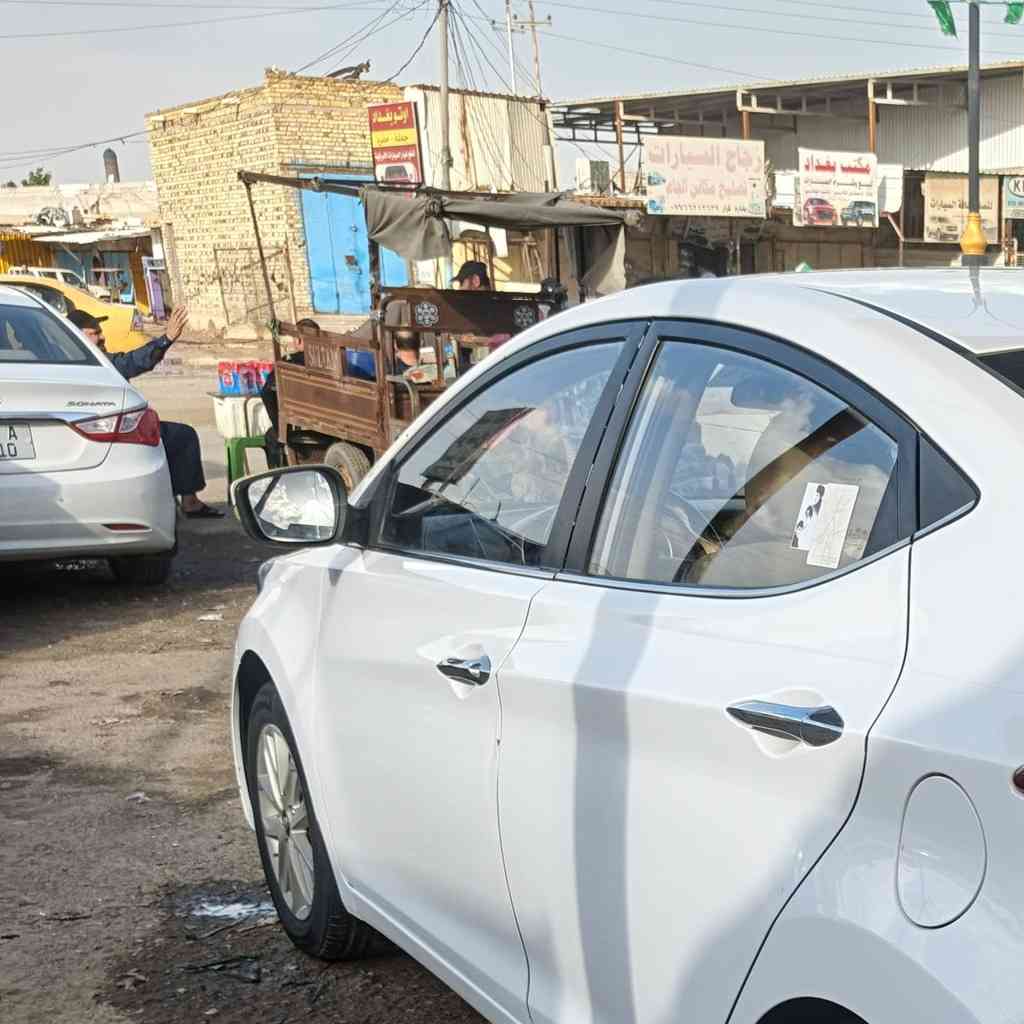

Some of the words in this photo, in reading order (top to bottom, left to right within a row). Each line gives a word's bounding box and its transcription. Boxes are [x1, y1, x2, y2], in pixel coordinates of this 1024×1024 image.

[649, 140, 721, 171] السيارات
[725, 141, 763, 173] زجاج
[804, 154, 836, 172] بغداد
[840, 157, 870, 173] مكتب
[8, 424, 18, 440] A
